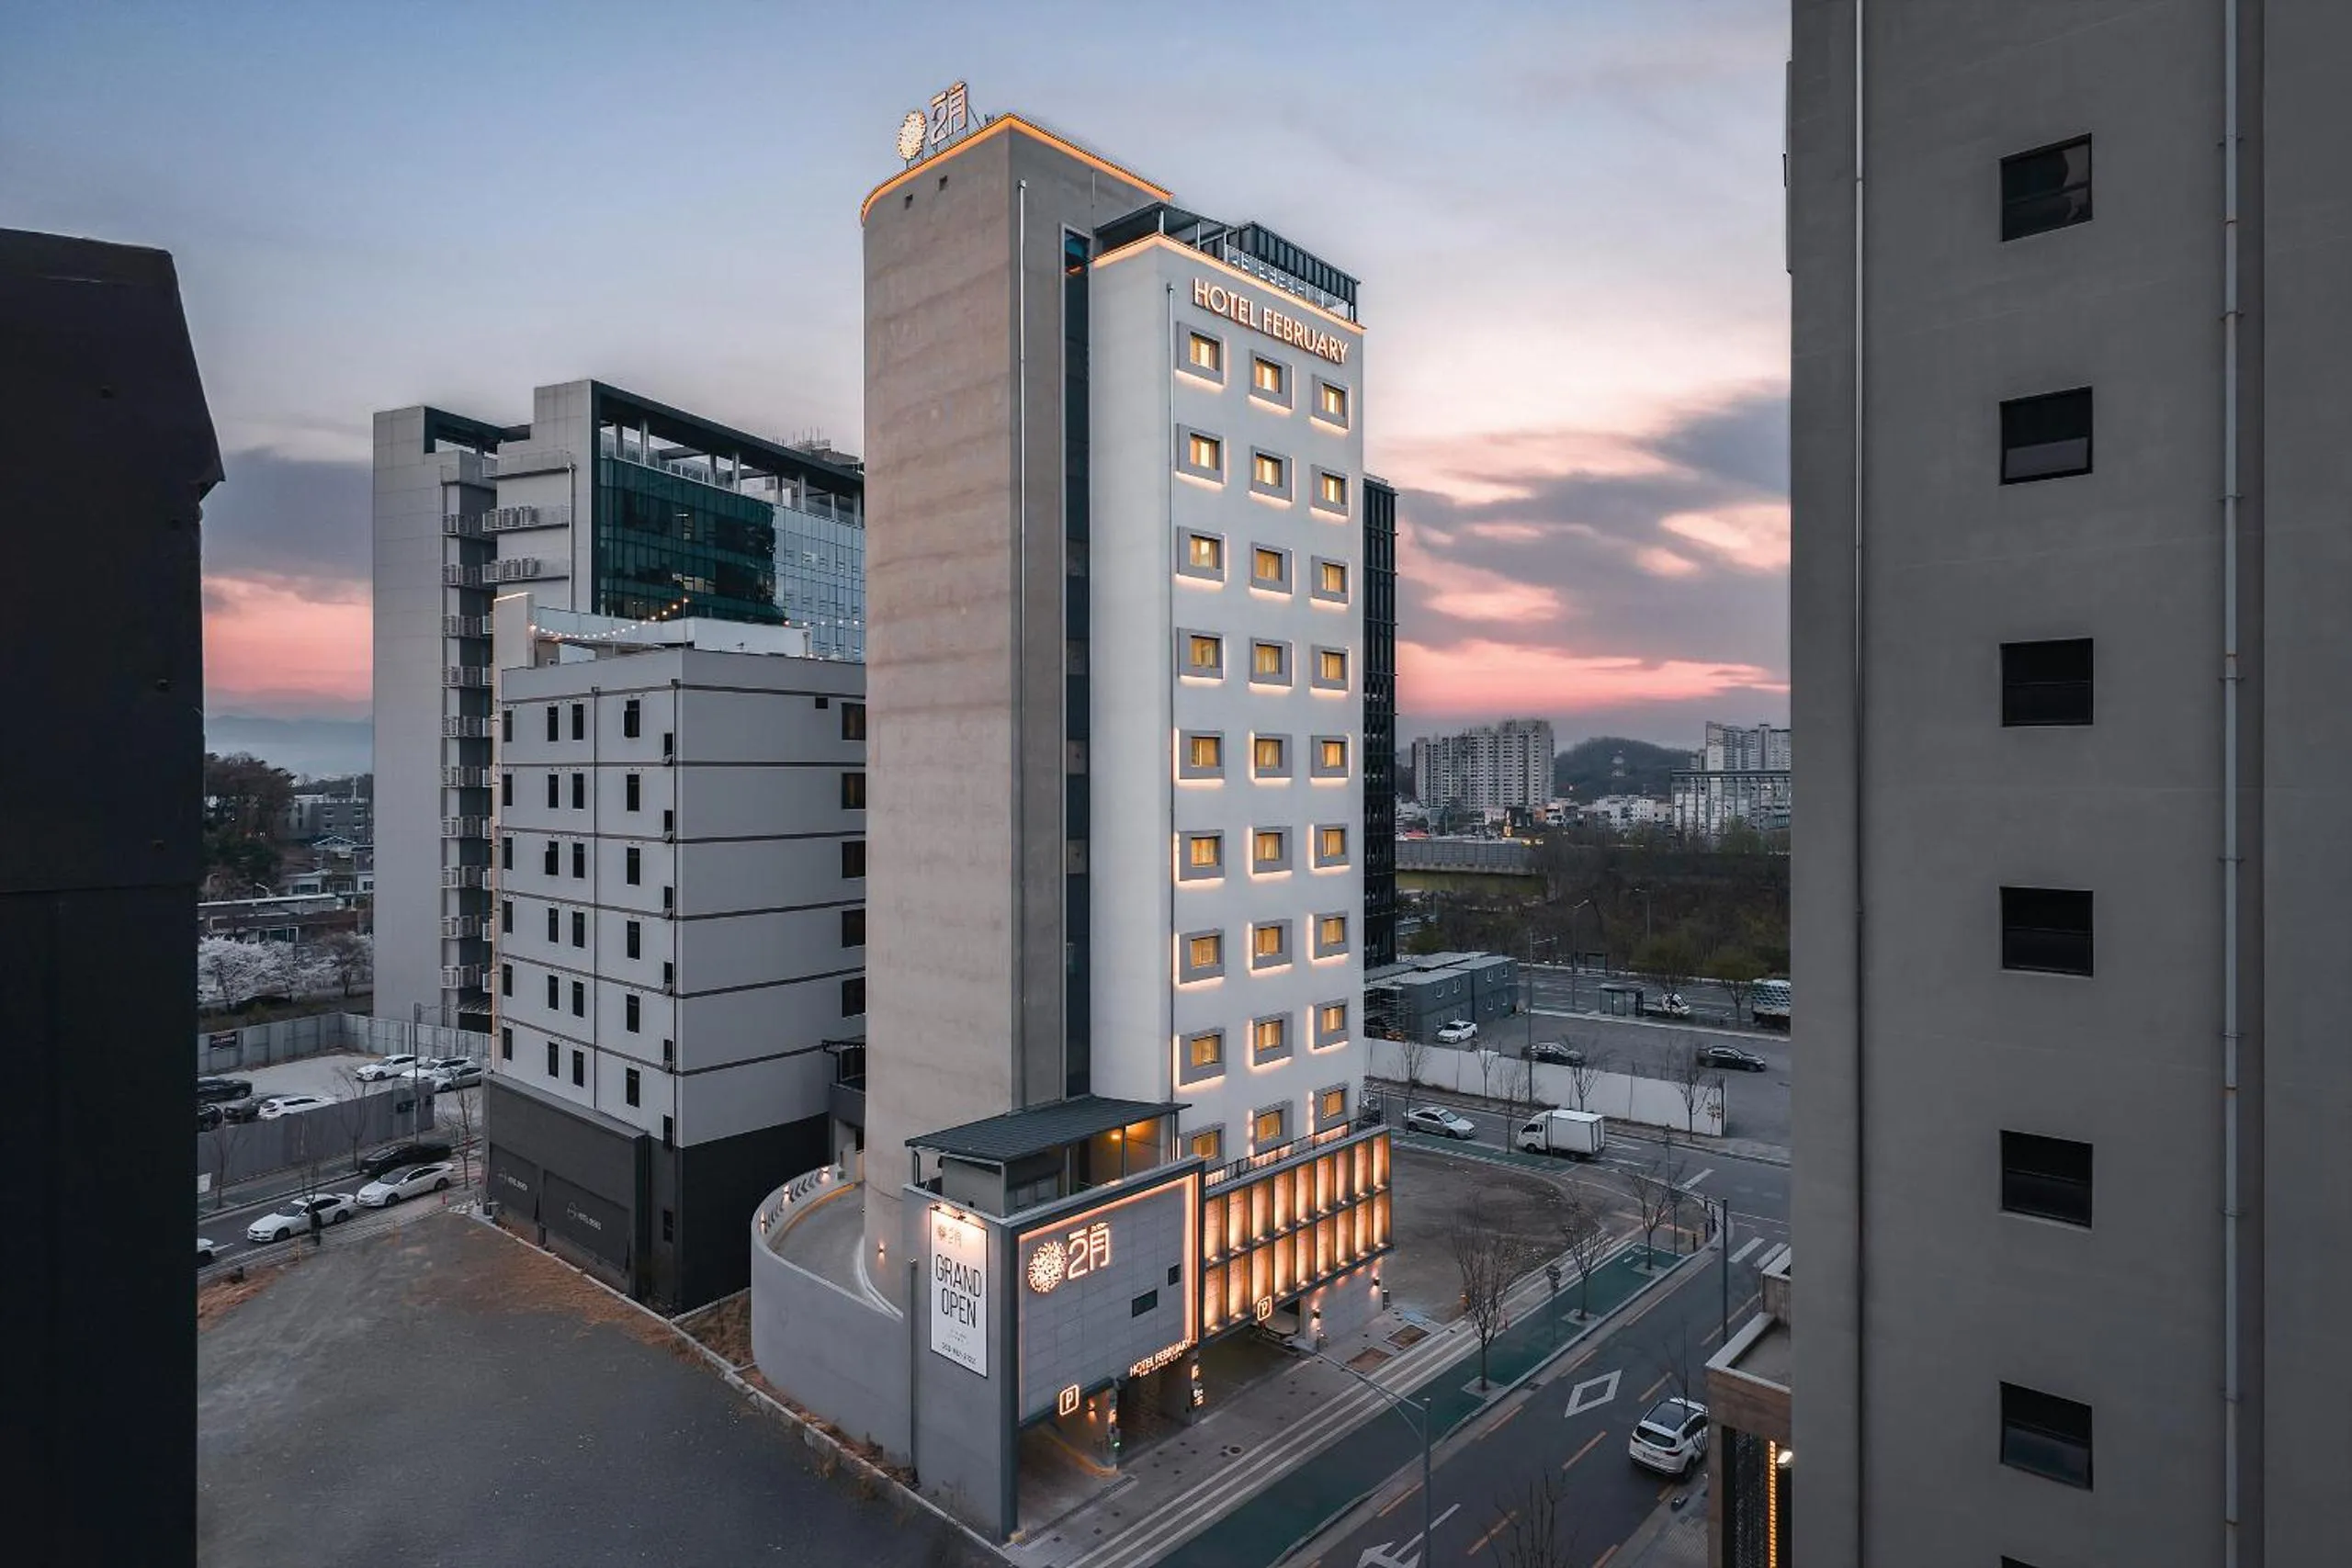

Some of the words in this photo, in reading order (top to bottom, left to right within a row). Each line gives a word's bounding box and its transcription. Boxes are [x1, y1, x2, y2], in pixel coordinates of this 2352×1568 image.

[1193, 277, 1257, 327] HOTEL
[1262, 306, 1349, 364] FEBRUARY
[935, 1253, 982, 1298] GRAND
[942, 1288, 976, 1328] OPEN
[1129, 1356, 1154, 1377] HOTEL
